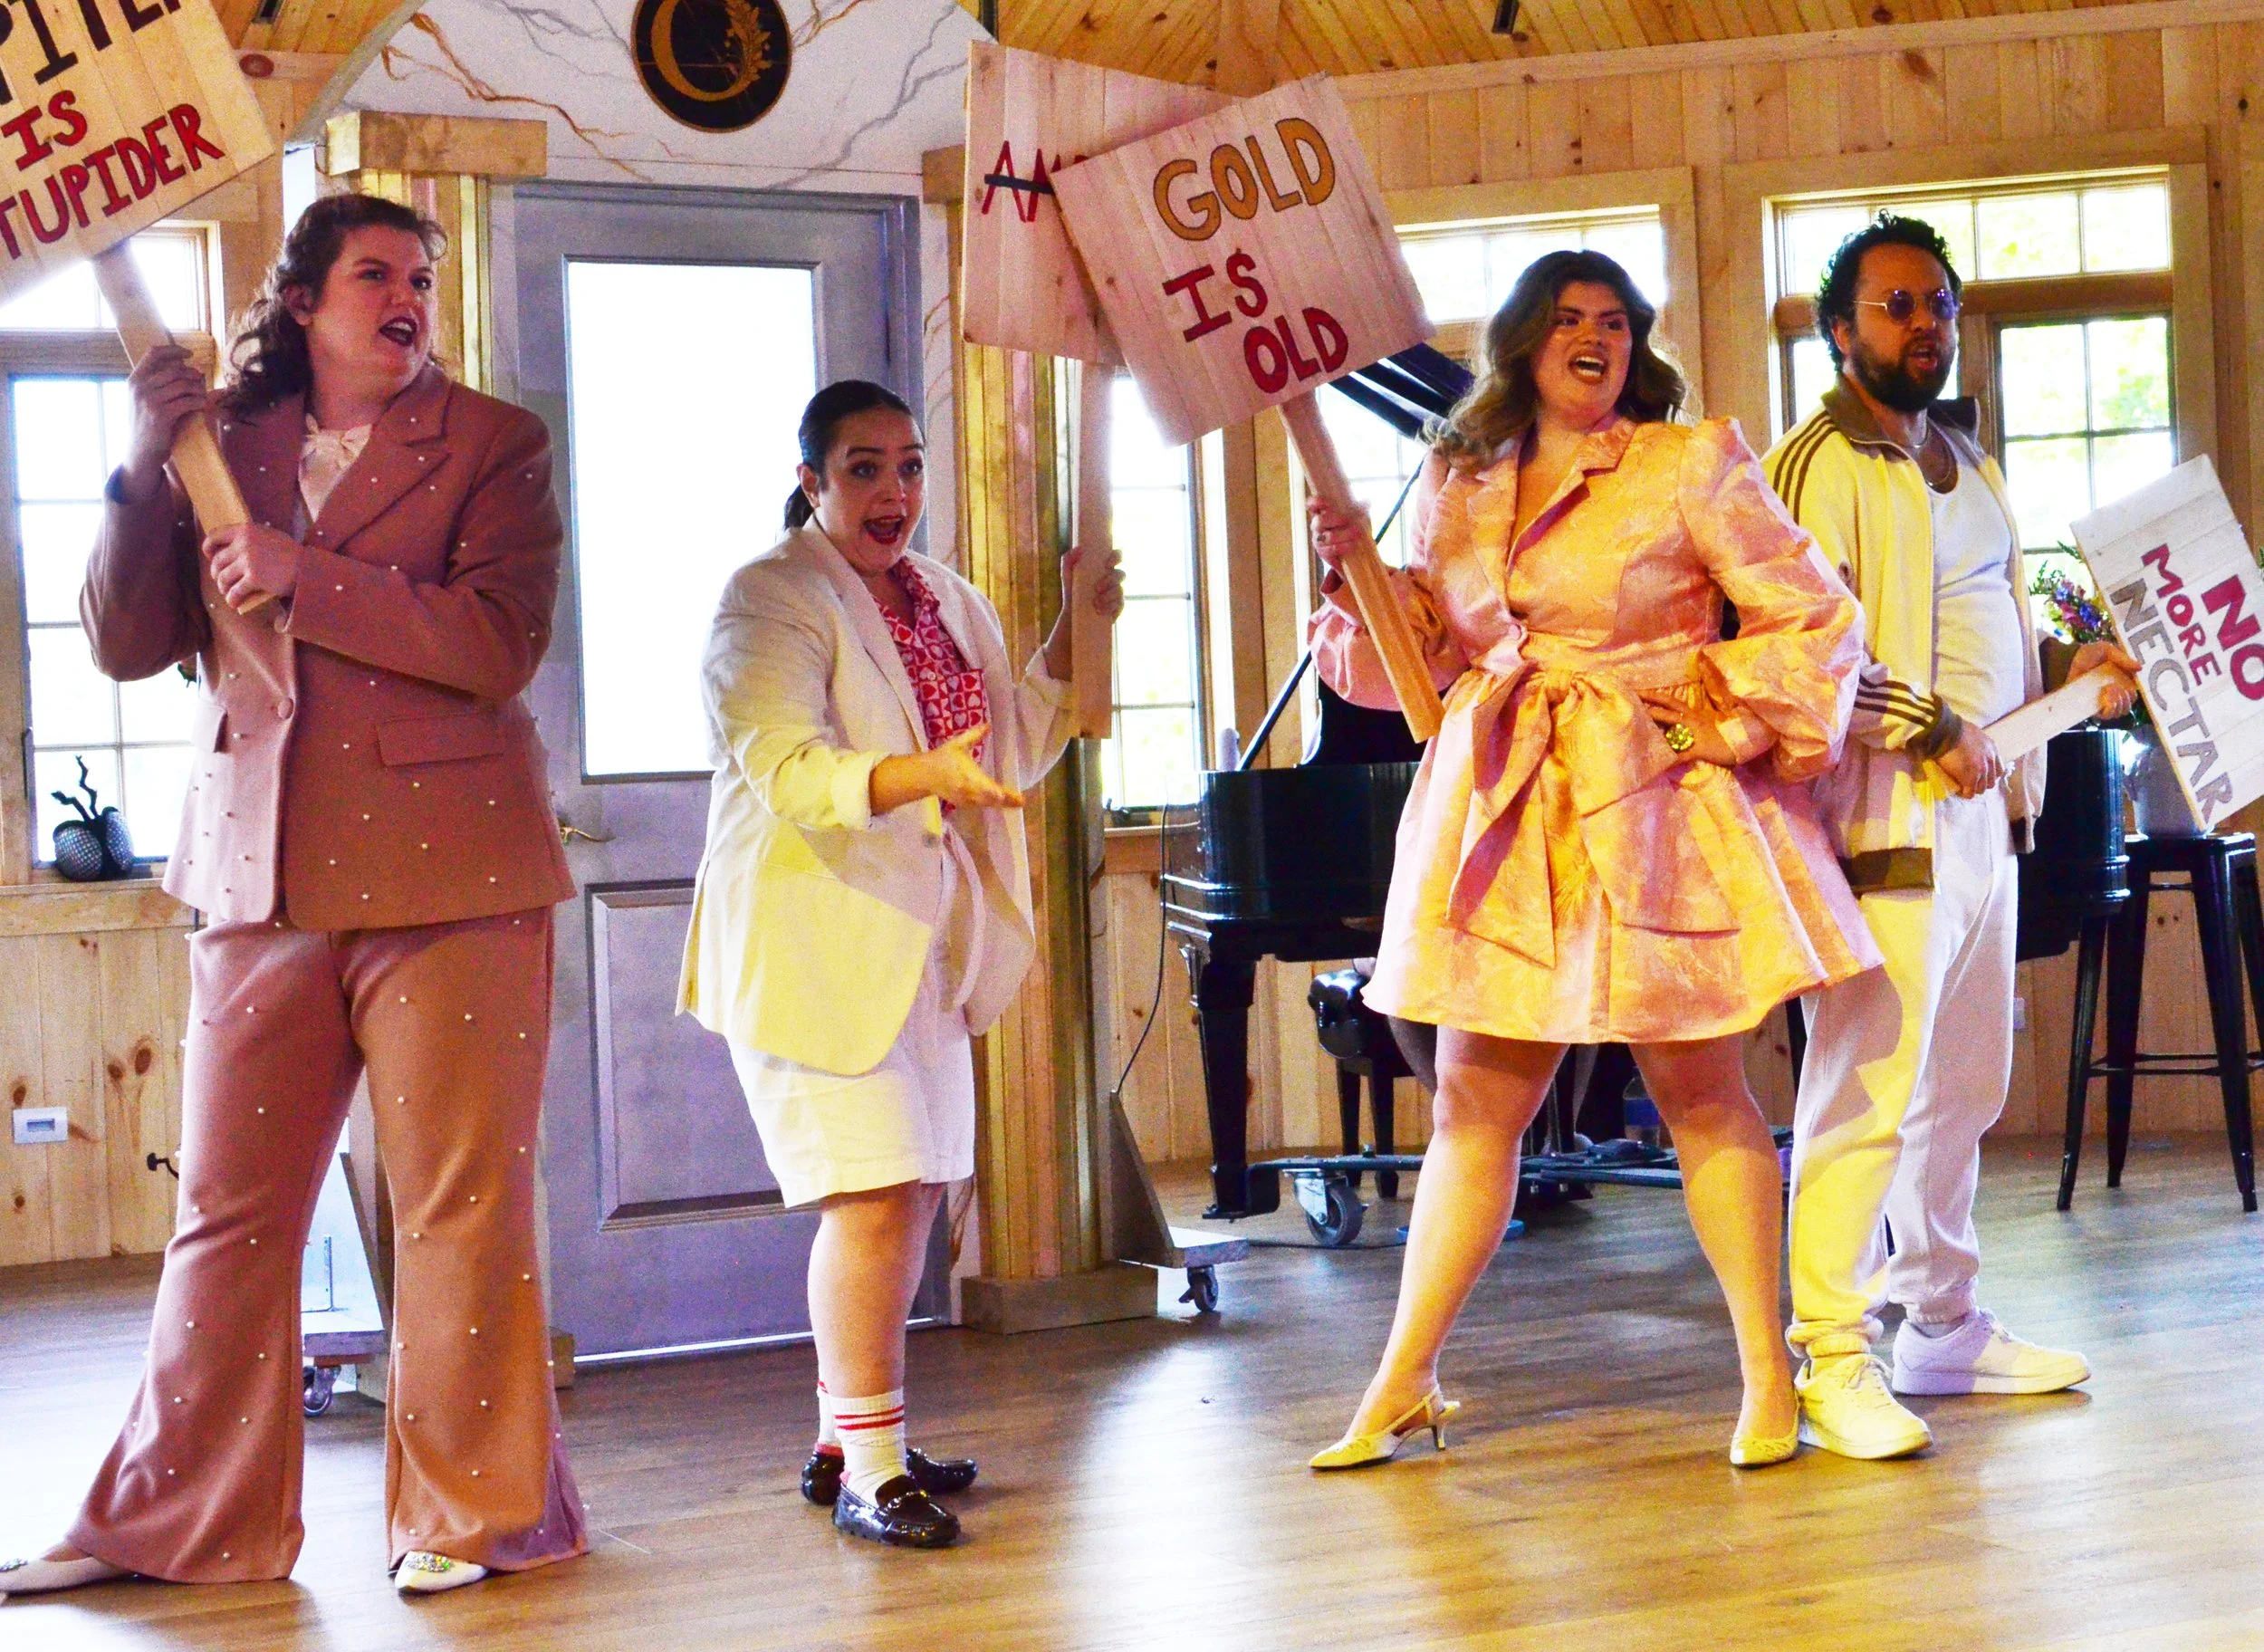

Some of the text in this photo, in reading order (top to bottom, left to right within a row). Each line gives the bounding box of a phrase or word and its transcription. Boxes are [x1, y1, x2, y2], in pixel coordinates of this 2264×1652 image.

[1, 90, 88, 171] IS
[1153, 118, 1336, 241] GOLD
[1162, 253, 1268, 342] IS
[1243, 307, 1348, 394] OLD
[2141, 543, 2221, 687] MORE
[2201, 574, 2264, 701] NO
[2108, 577, 2234, 825] NECTAR
